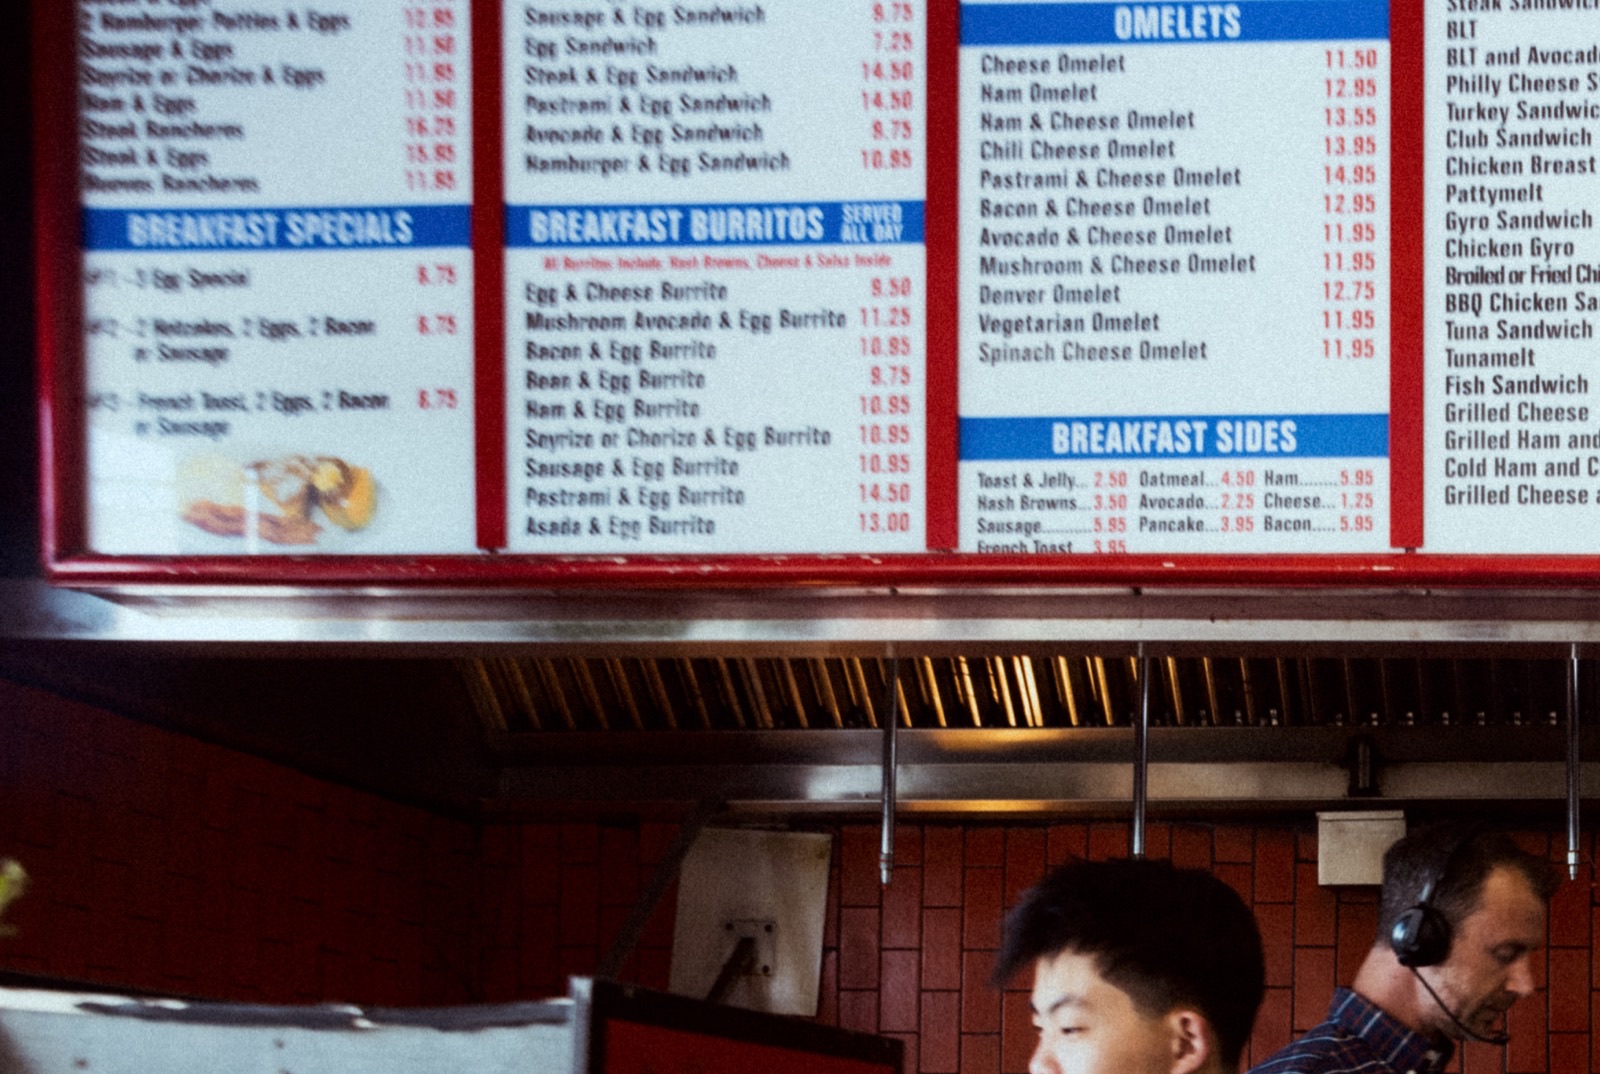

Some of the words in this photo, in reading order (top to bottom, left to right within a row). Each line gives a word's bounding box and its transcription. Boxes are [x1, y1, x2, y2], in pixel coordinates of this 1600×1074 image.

[1115, 5, 1240, 40] OMELETS
[981, 54, 1050, 74] Cheese
[1058, 52, 1124, 73] Omelet
[1326, 49, 1377, 68] 11.50
[1447, 47, 1476, 67] BLT
[1485, 47, 1520, 66] and
[1447, 75, 1501, 97] Philly
[1509, 72, 1579, 93] Cheese
[980, 139, 1023, 160] Chili
[1031, 139, 1100, 159] Cheese
[1108, 139, 1174, 158] Omelet
[1325, 136, 1376, 155] 13.95
[1446, 128, 1488, 148] Club
[1496, 127, 1592, 147] Sandwich
[980, 169, 1068, 189] Pastrami
[1076, 169, 1088, 188] &
[1096, 168, 1165, 187] Cheese
[1173, 166, 1240, 187] Omelet
[1325, 165, 1376, 184] 14.95
[1446, 183, 1542, 206] Pattymelt
[843, 203, 901, 221] SERVED
[1446, 211, 1489, 235] Gyro
[1497, 210, 1592, 229] Sandwich
[128, 214, 277, 245] BREAKFAST
[286, 212, 412, 244] SPECIALS
[531, 209, 682, 242] BREAKFAST
[691, 208, 823, 240] BURRITOS
[842, 222, 867, 243] ALL
[874, 221, 901, 241] DAY
[1445, 237, 1523, 258] Chicken
[1530, 237, 1574, 261] Gyro
[980, 255, 1082, 275] Mushroom
[1090, 257, 1103, 274] &
[1111, 254, 1180, 274] Cheese
[1188, 253, 1255, 273] Omelet
[1324, 252, 1375, 271] 11.95
[1446, 292, 1482, 317] BBQ
[1490, 293, 1567, 312] Chicken
[525, 311, 626, 331] Mushroom
[634, 311, 711, 330] Avocado
[719, 311, 731, 328] &
[739, 311, 771, 333] Egg
[780, 308, 846, 328] Burrito
[861, 307, 911, 327] 11.25
[979, 314, 1084, 337] Vegetarian
[1092, 311, 1159, 332] Omelet
[1323, 310, 1375, 330] 11.95
[1446, 320, 1489, 340] Tuna
[1497, 320, 1592, 339] Sandwich
[979, 341, 1055, 365] Spinach
[1063, 341, 1132, 361] Cheese
[1139, 339, 1207, 361] Omelet
[1323, 339, 1375, 358] 11.95
[1446, 348, 1534, 367] Tunamelt
[1445, 376, 1485, 395] Fish
[1492, 374, 1588, 395] Sandwich
[1445, 402, 1510, 423] Grilled
[1518, 402, 1589, 422] Cheese
[1053, 421, 1207, 454] BREAKFAST
[1216, 419, 1297, 452] SIDES
[525, 486, 610, 506] Pastrami
[618, 488, 630, 505] &
[638, 487, 670, 510] Egg
[678, 486, 744, 504] Burrito
[860, 483, 910, 502] 14.50
[1445, 484, 1510, 506] Grilled
[1517, 484, 1588, 504] Cheese
[526, 517, 581, 536] Asada
[588, 516, 601, 536] &
[609, 516, 640, 539] Egg
[649, 514, 715, 535] Burrito
[860, 512, 910, 533] 13.00
